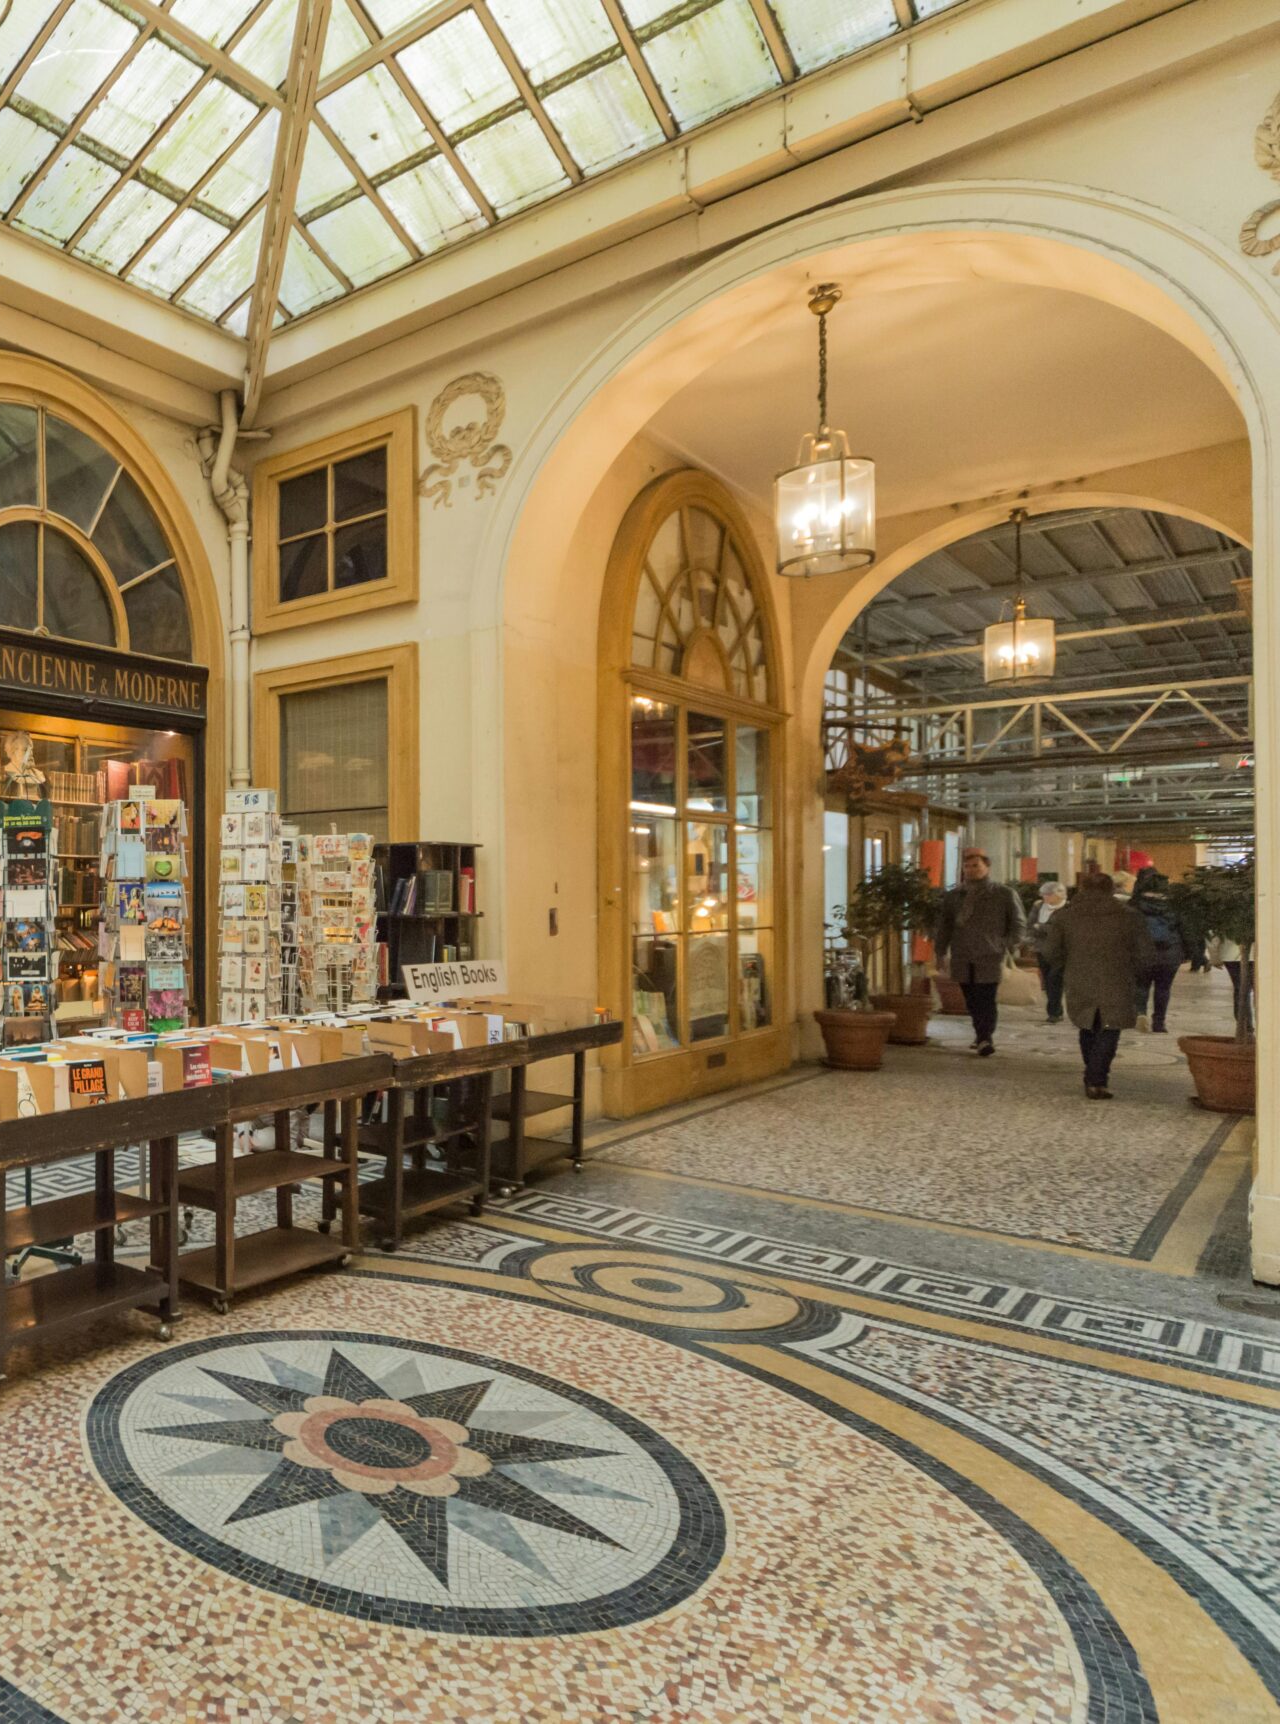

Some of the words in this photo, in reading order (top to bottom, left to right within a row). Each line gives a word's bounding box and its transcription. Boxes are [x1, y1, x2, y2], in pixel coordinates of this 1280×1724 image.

[100, 678, 109, 696] &
[115, 668, 201, 710] MODERNE
[410, 966, 459, 993] English
[460, 963, 497, 985] Books
[73, 1068, 81, 1079] LE
[81, 1066, 104, 1079] GRAND
[74, 1078, 105, 1093] PILLAGE
